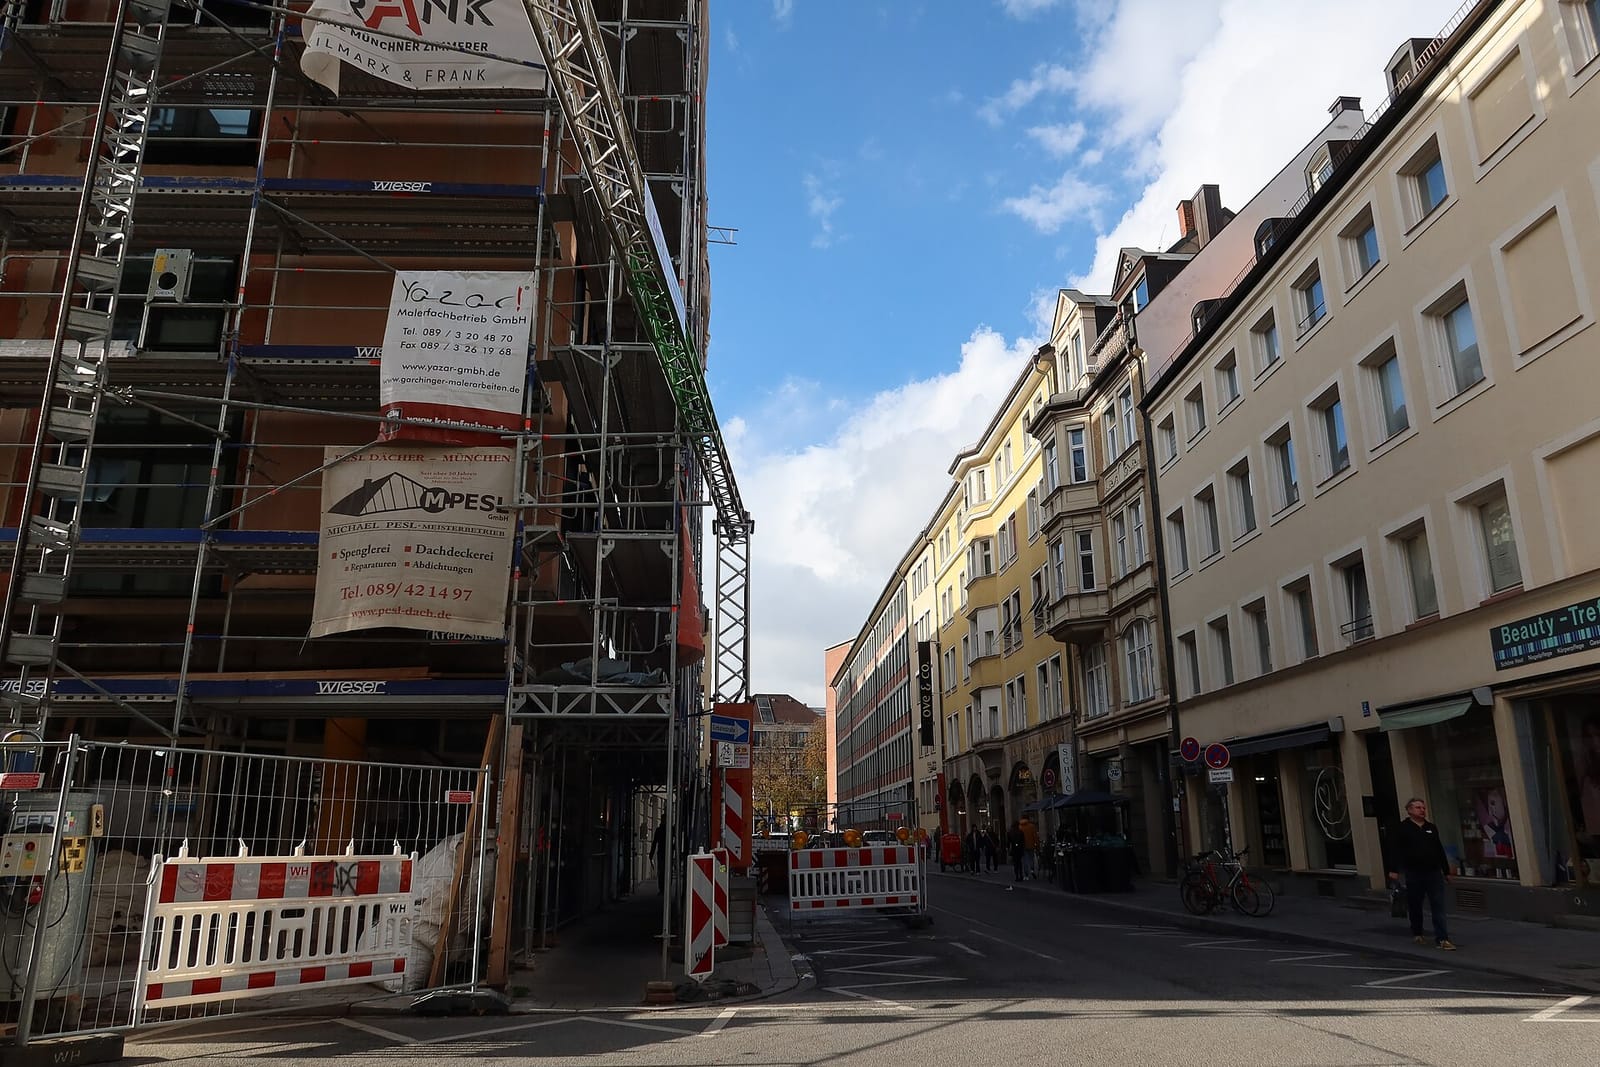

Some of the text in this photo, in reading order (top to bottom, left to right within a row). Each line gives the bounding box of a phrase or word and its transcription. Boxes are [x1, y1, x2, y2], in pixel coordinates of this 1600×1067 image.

[350, 32, 420, 52] MÜNCHNER
[307, 37, 486, 82] ILMARX & FRANK
[397, 308, 527, 325] Malerfachbetrieb GmbH
[402, 327, 513, 343] Tel. 089 / 3 20 48 70
[400, 341, 512, 356] Fax 089 / 3 26 19 68
[402, 362, 501, 378] www.yazar-gmbh.de
[369, 452, 424, 463] DÄCHER
[442, 452, 511, 463] MÜNCHEN
[487, 514, 509, 522] GmbH
[327, 521, 380, 536] MICHAEL
[339, 544, 494, 562] Spenglerei Dachdeckerei
[350, 560, 474, 575] Reparaturen Abdichtungen
[340, 585, 363, 600] Tel.
[351, 605, 452, 620] www.pesl-dach.de
[1501, 617, 1554, 645] Beauty
[290, 866, 309, 876] WH
[389, 903, 406, 913] WH
[54, 1050, 80, 1063] WH
